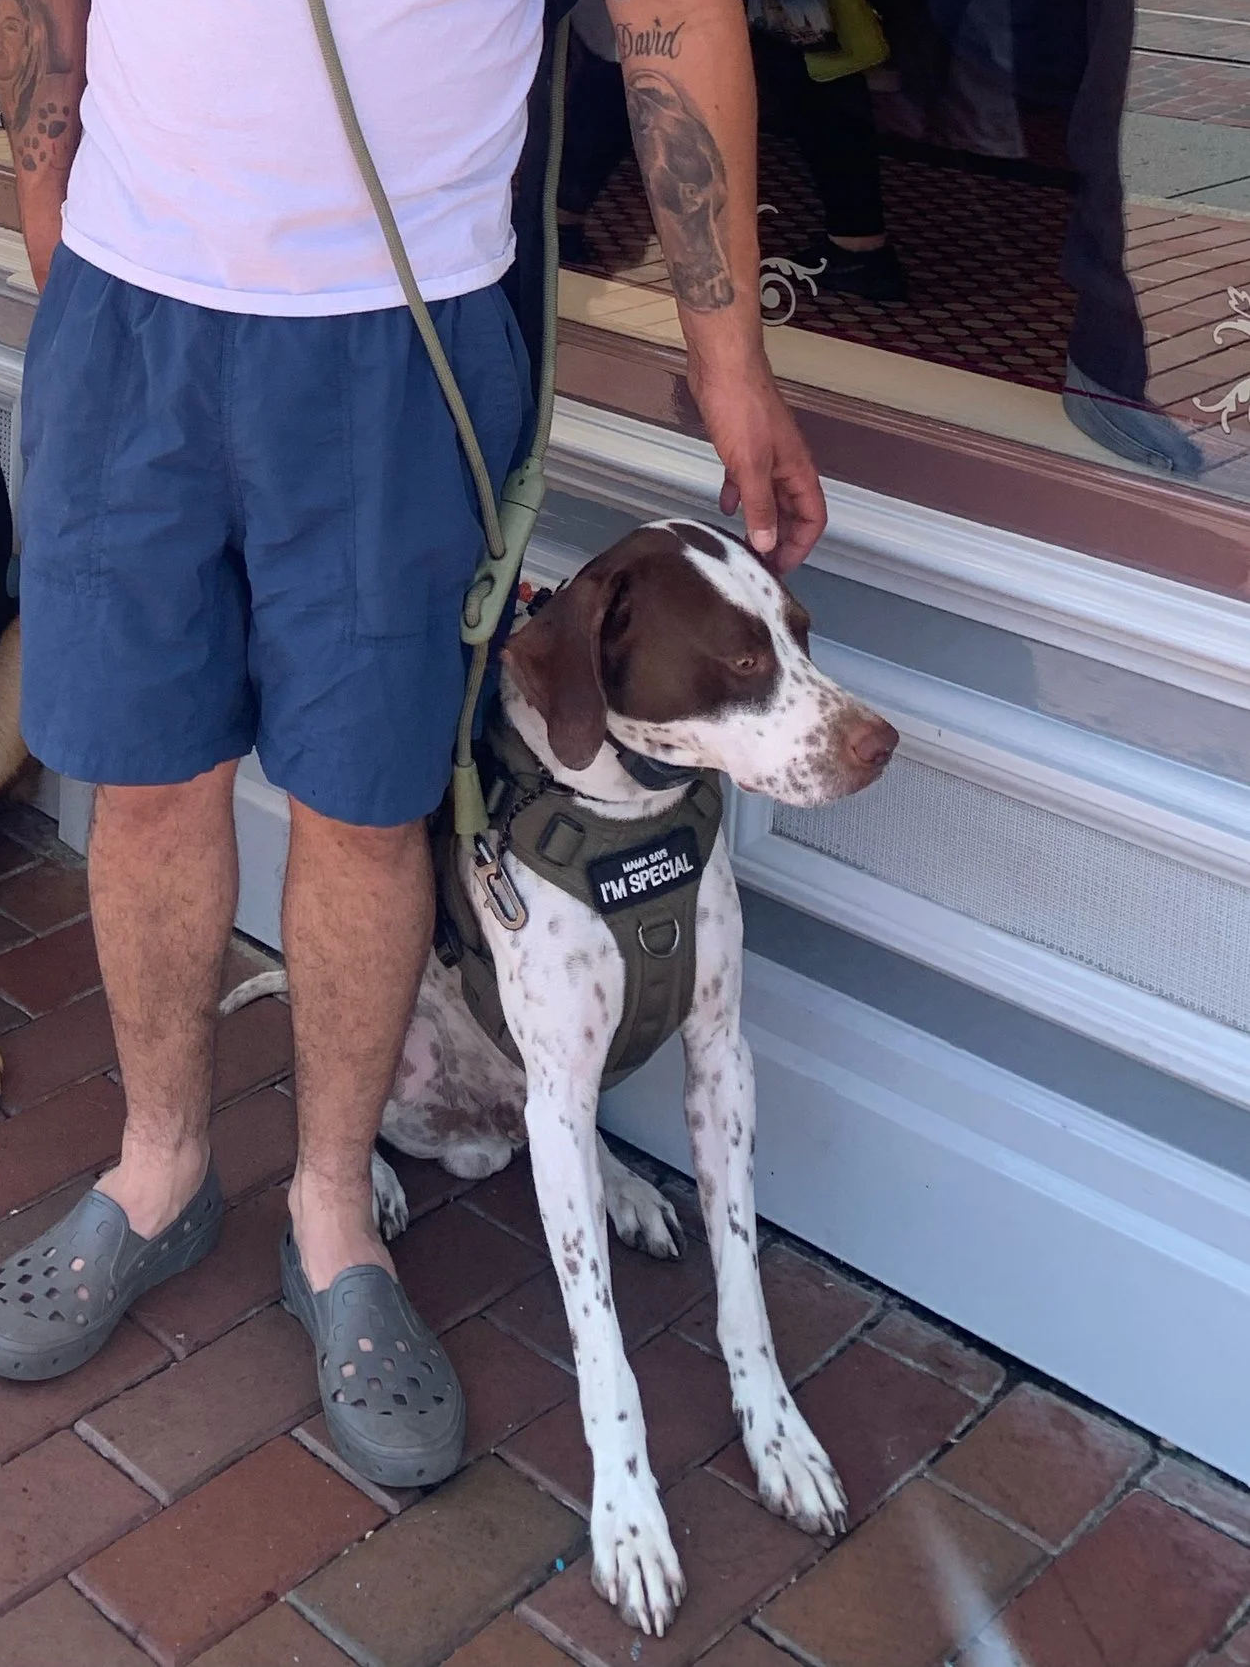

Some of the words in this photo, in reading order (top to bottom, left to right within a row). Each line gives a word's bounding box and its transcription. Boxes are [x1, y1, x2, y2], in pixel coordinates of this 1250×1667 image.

[616, 16, 686, 60] David
[600, 877, 628, 903] I'M
[628, 853, 694, 894] SPECIAL
[621, 858, 649, 874] MAMA
[649, 848, 669, 864] SAYS
